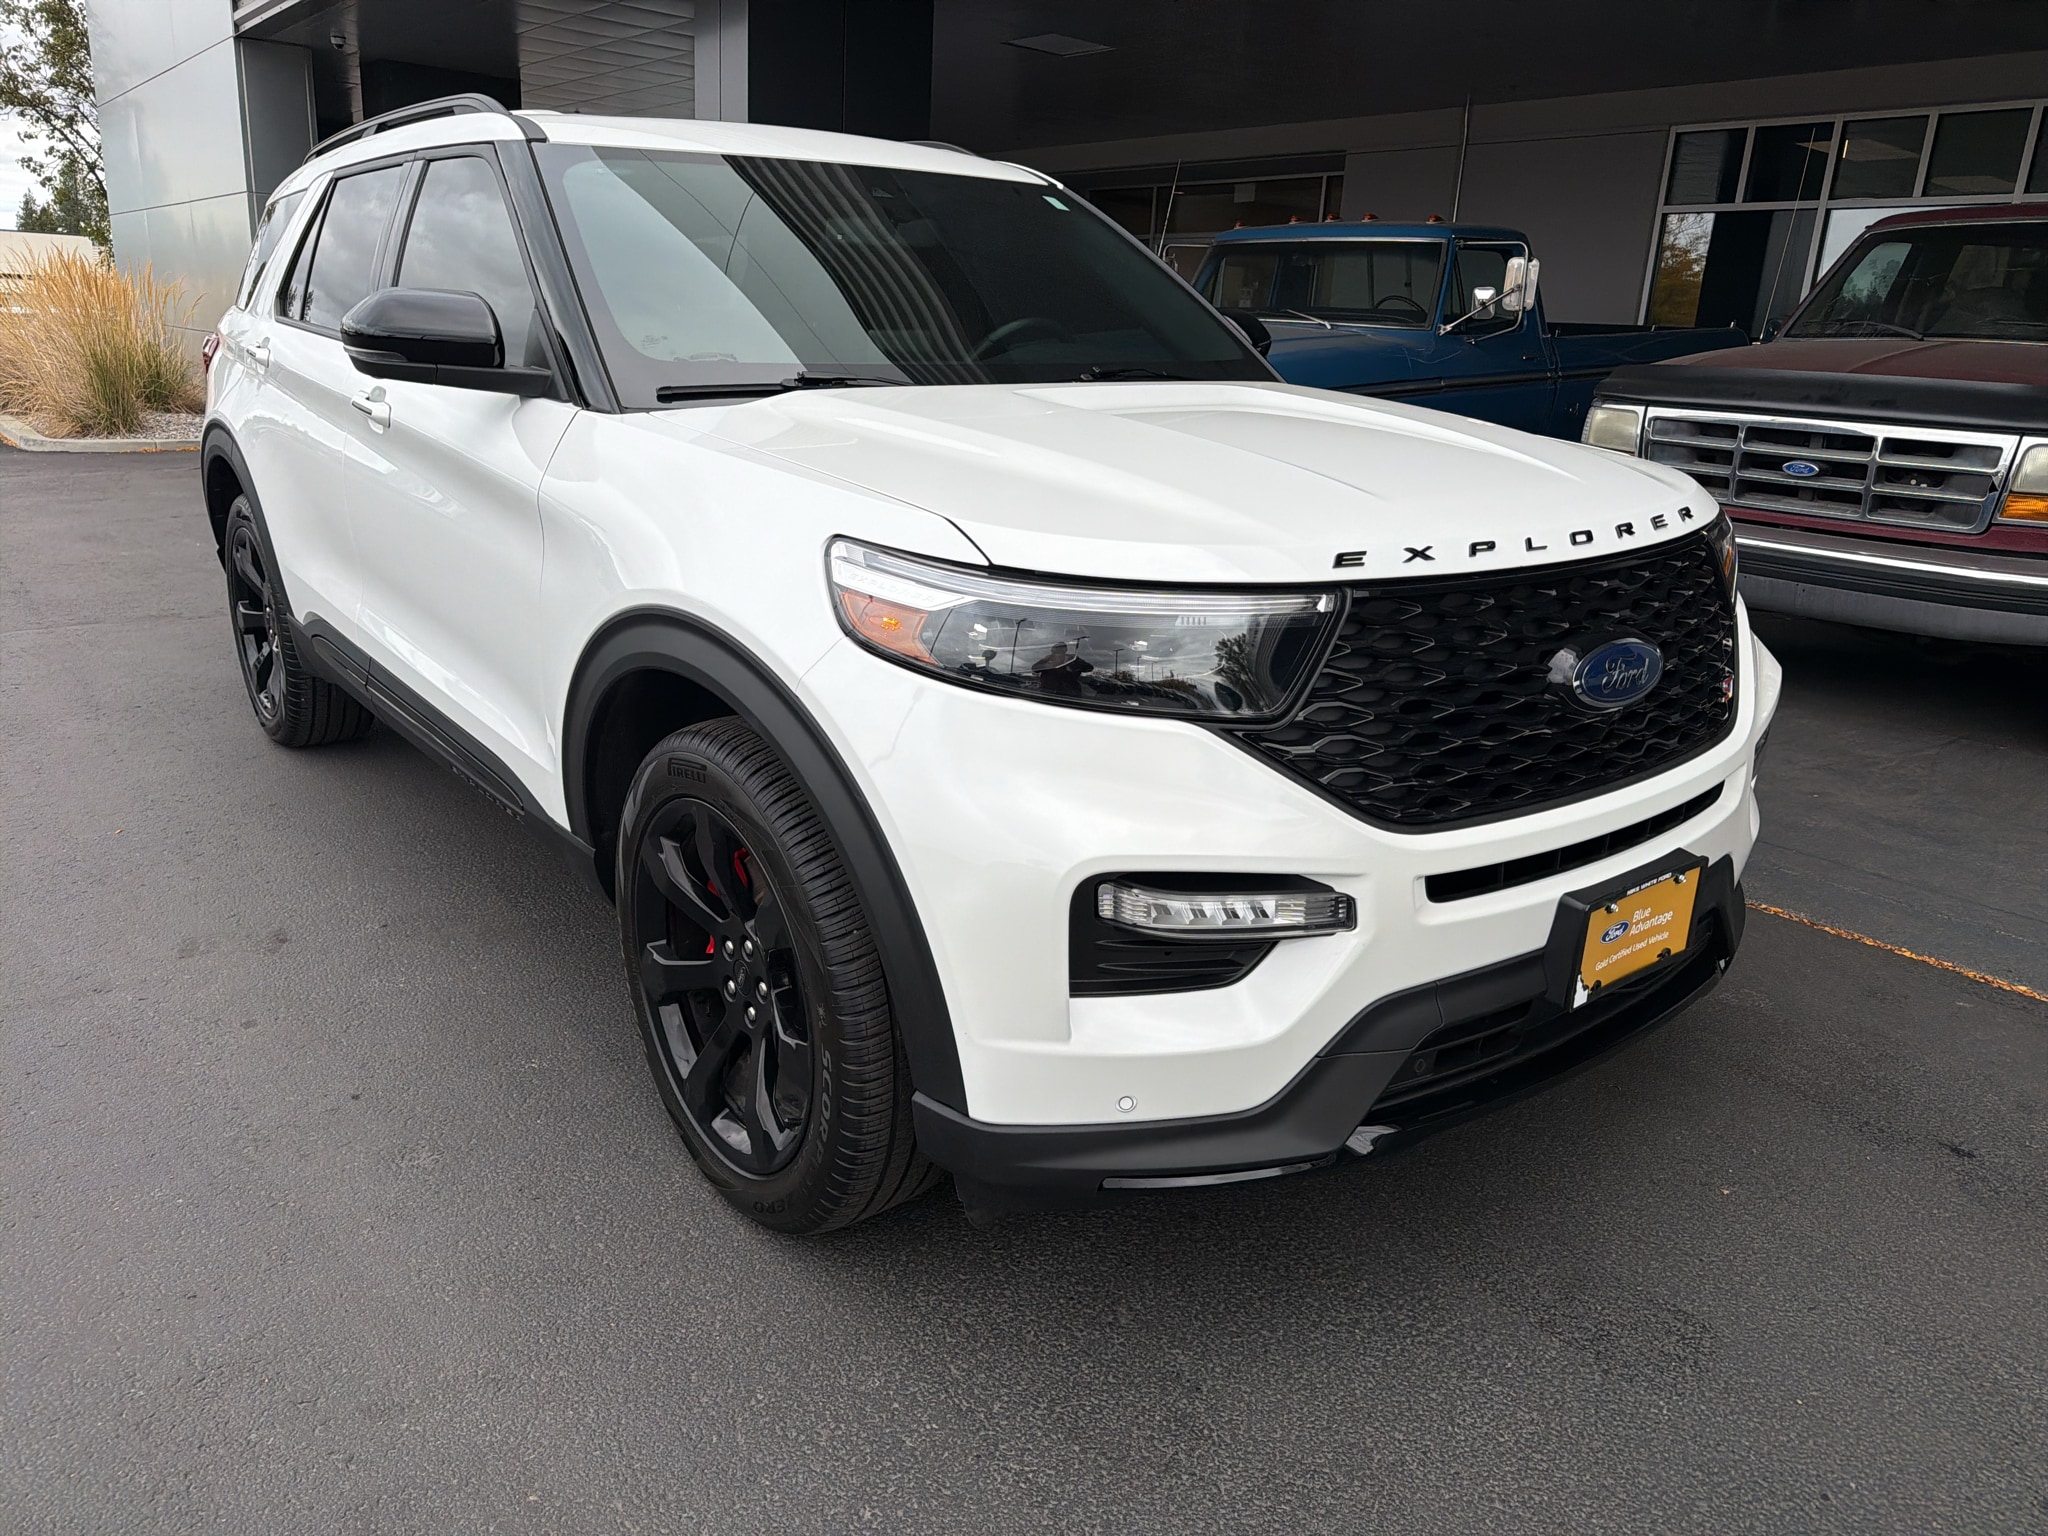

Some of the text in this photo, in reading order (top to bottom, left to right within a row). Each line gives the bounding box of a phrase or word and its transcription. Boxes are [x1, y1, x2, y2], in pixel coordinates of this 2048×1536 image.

[1332, 505, 1695, 569] EXPLORER
[1602, 651, 1649, 693] Ford
[667, 757, 707, 784] PIRELLI
[1658, 872, 1672, 882] FORD
[1629, 911, 1674, 936] Advantage
[1633, 907, 1651, 922] Blue
[1596, 931, 1669, 971] Gold Certified Used Vehicle
